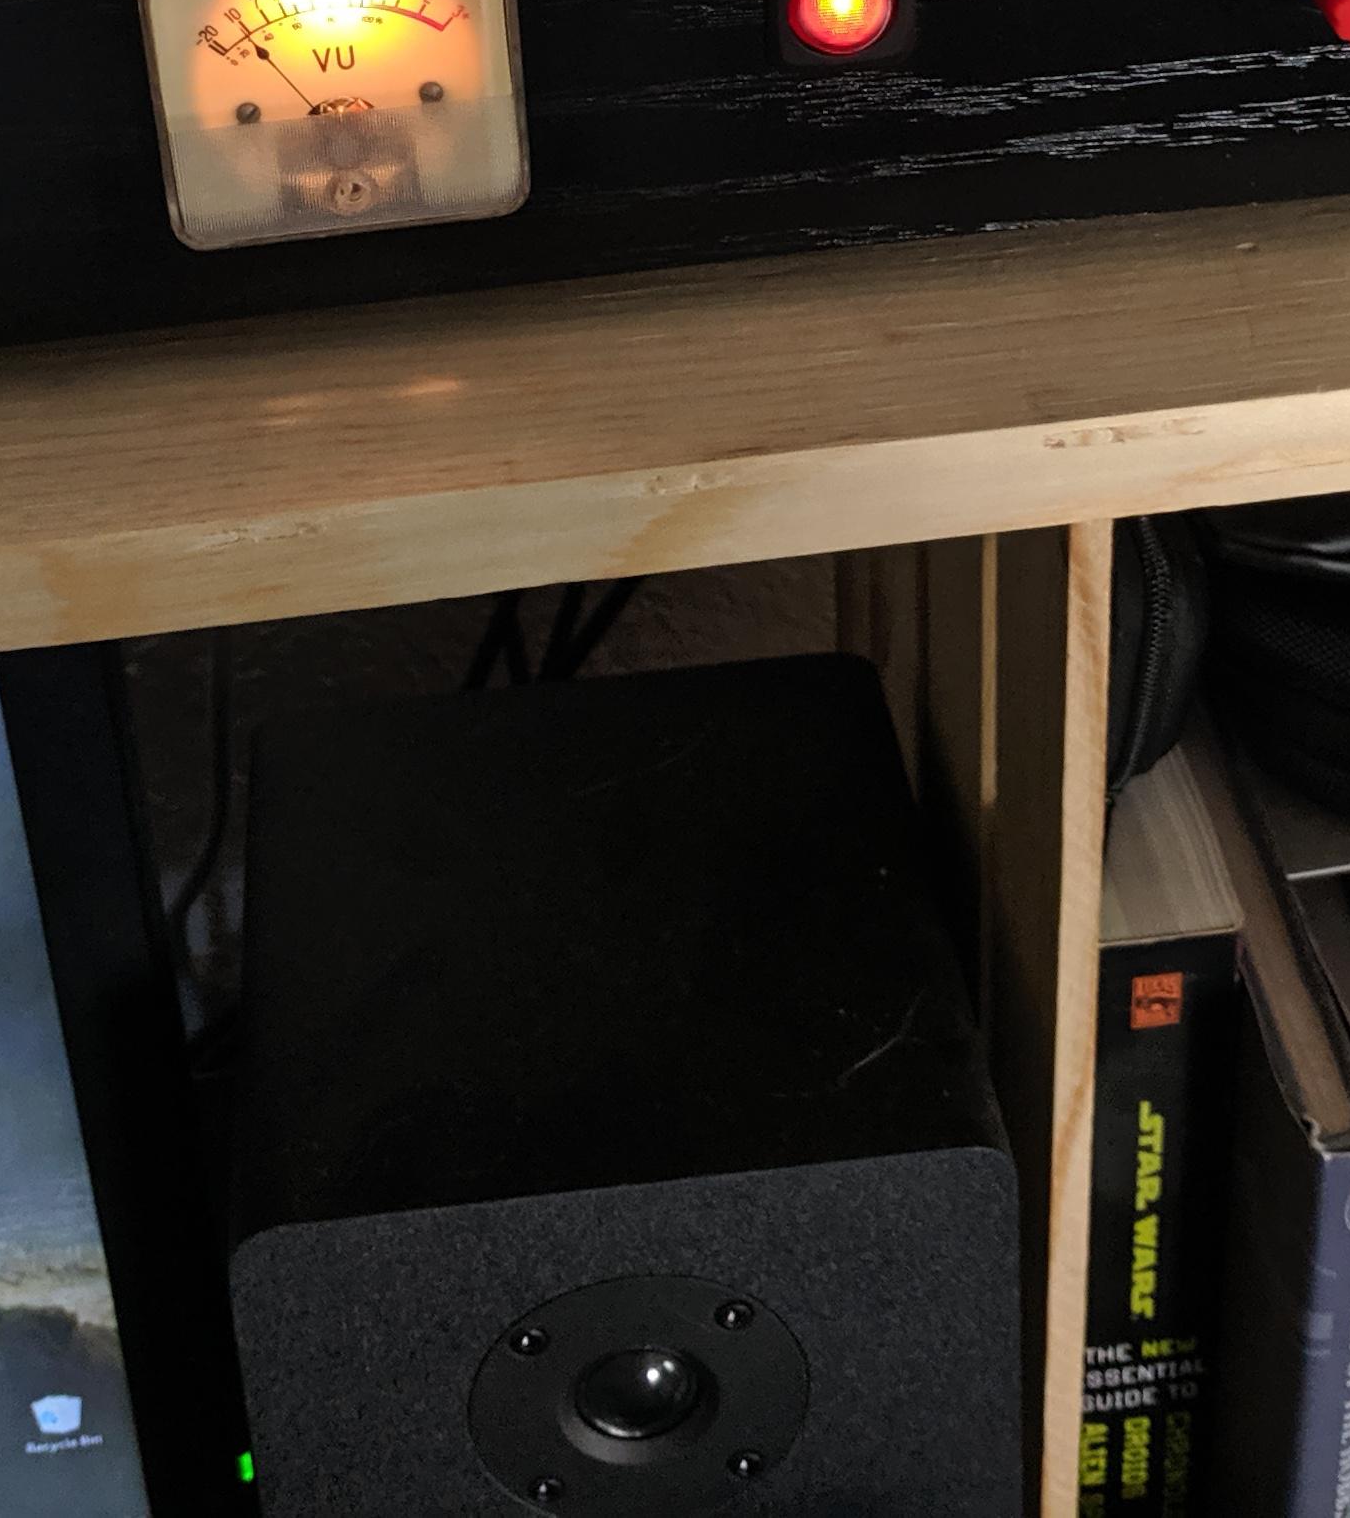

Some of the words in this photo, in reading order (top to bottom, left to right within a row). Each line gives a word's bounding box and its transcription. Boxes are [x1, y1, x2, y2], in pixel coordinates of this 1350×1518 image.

[223, 7, 243, 23] 10
[311, 44, 356, 73] VU
[1135, 1100, 1165, 1211] STAR
[1130, 1214, 1160, 1319] WARS
[1085, 1342, 1133, 1365] THE
